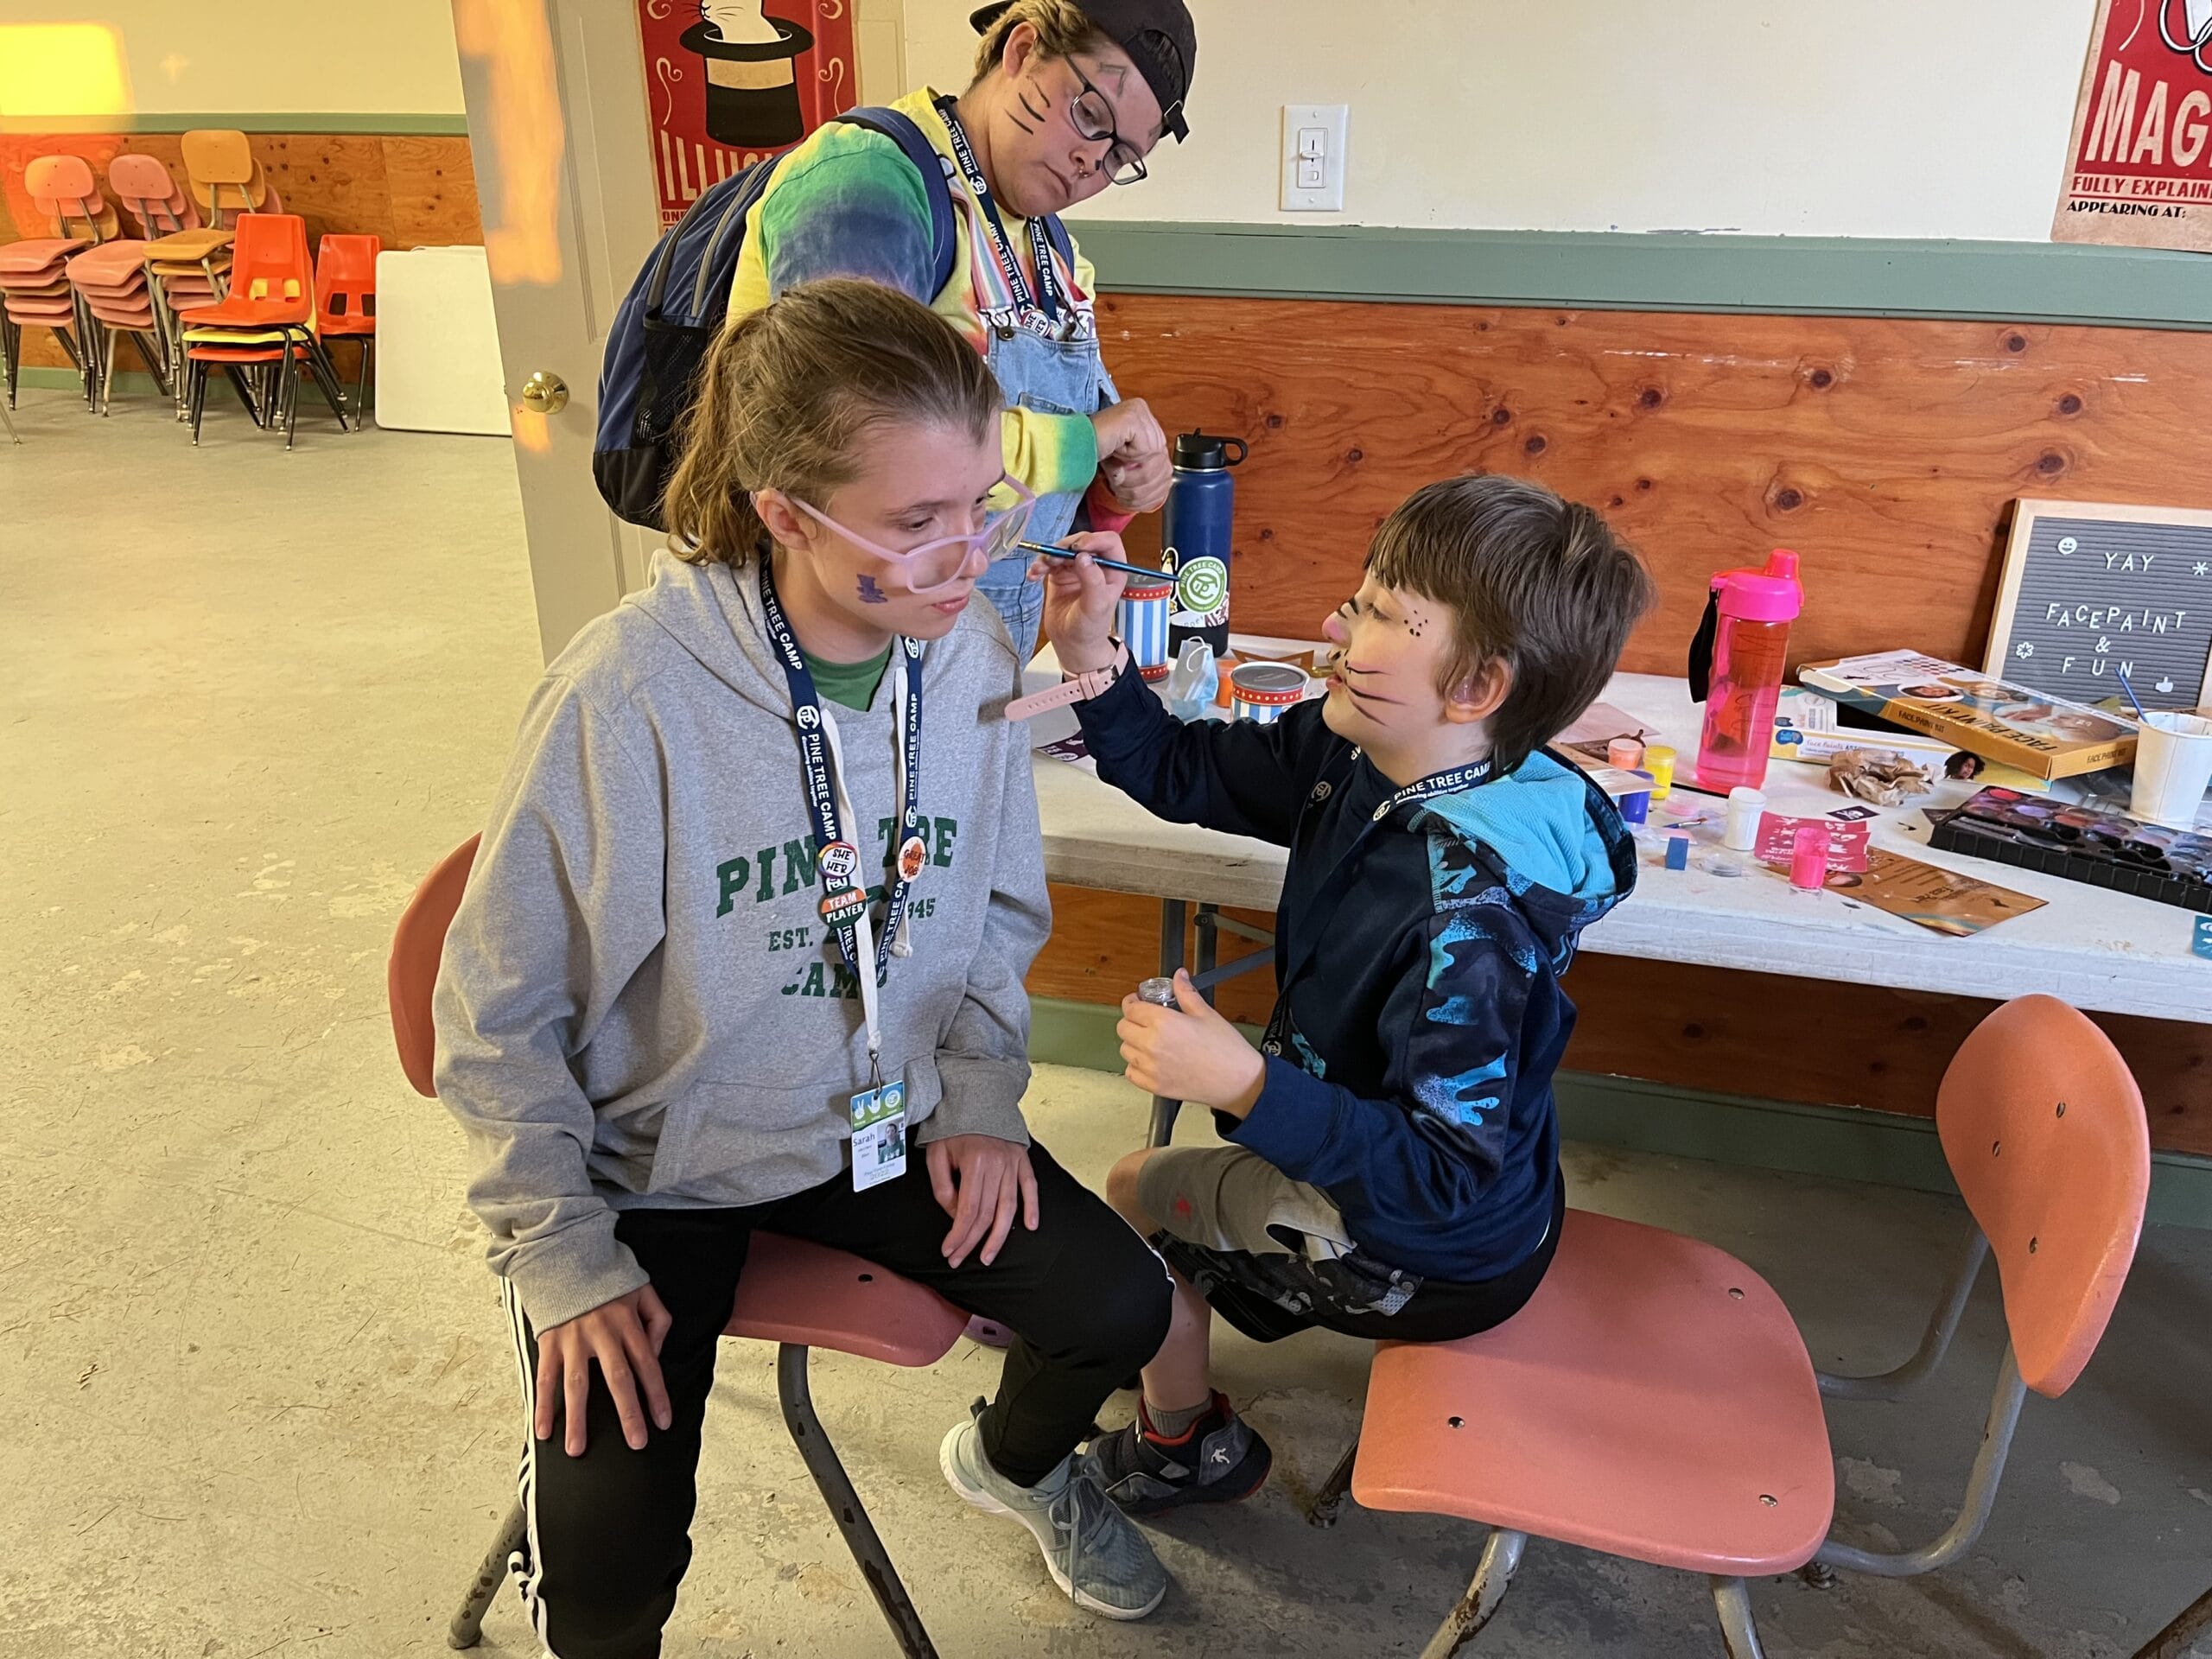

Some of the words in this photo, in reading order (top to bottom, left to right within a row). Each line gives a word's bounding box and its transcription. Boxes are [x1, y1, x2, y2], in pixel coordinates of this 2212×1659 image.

[938, 108, 952, 127] CAMP
[2084, 59, 2212, 168] MAG
[950, 126, 964, 150] TREE
[660, 130, 772, 201] ILLU
[958, 149, 975, 175] PINE
[2071, 175, 2126, 194] FULLY
[2131, 179, 2212, 200] EXPLAIN
[2066, 200, 2158, 217] APPEARING
[1033, 223, 1044, 243] PINE
[1001, 251, 1014, 278] TREE
[1038, 243, 1049, 266] TREE
[1010, 279, 1026, 302] PINE
[1042, 266, 1053, 296] CAMP
[1024, 313, 1037, 329] SHE
[2105, 552, 2154, 573] YAY
[2046, 603, 2187, 633] FACEPAINT
[766, 597, 785, 632] TREE
[779, 632, 803, 671] CAMP
[2094, 636, 2112, 653] &
[2062, 657, 2133, 678] FUN
[1920, 703, 1955, 715] KIT
[808, 734, 823, 764] PINE
[908, 734, 917, 768] TREE
[2003, 728, 2058, 752] FACE
[814, 766, 830, 800] TREE
[1394, 781, 1426, 800] PINE
[1426, 772, 1463, 789] TREE
[820, 802, 837, 840] CAMP
[832, 849, 852, 861] SHE
[904, 849, 926, 864] GREAT
[716, 834, 817, 918] PIN
[826, 861, 848, 874] HER
[828, 891, 857, 910] TEAM
[768, 927, 813, 952] EST.
[907, 898, 936, 920] 945
[826, 902, 864, 924] PLAYER
[880, 937, 889, 962] PINE
[887, 901, 900, 935] TREE
[894, 880, 906, 898] CA
[853, 1134, 875, 1147] Sarah
